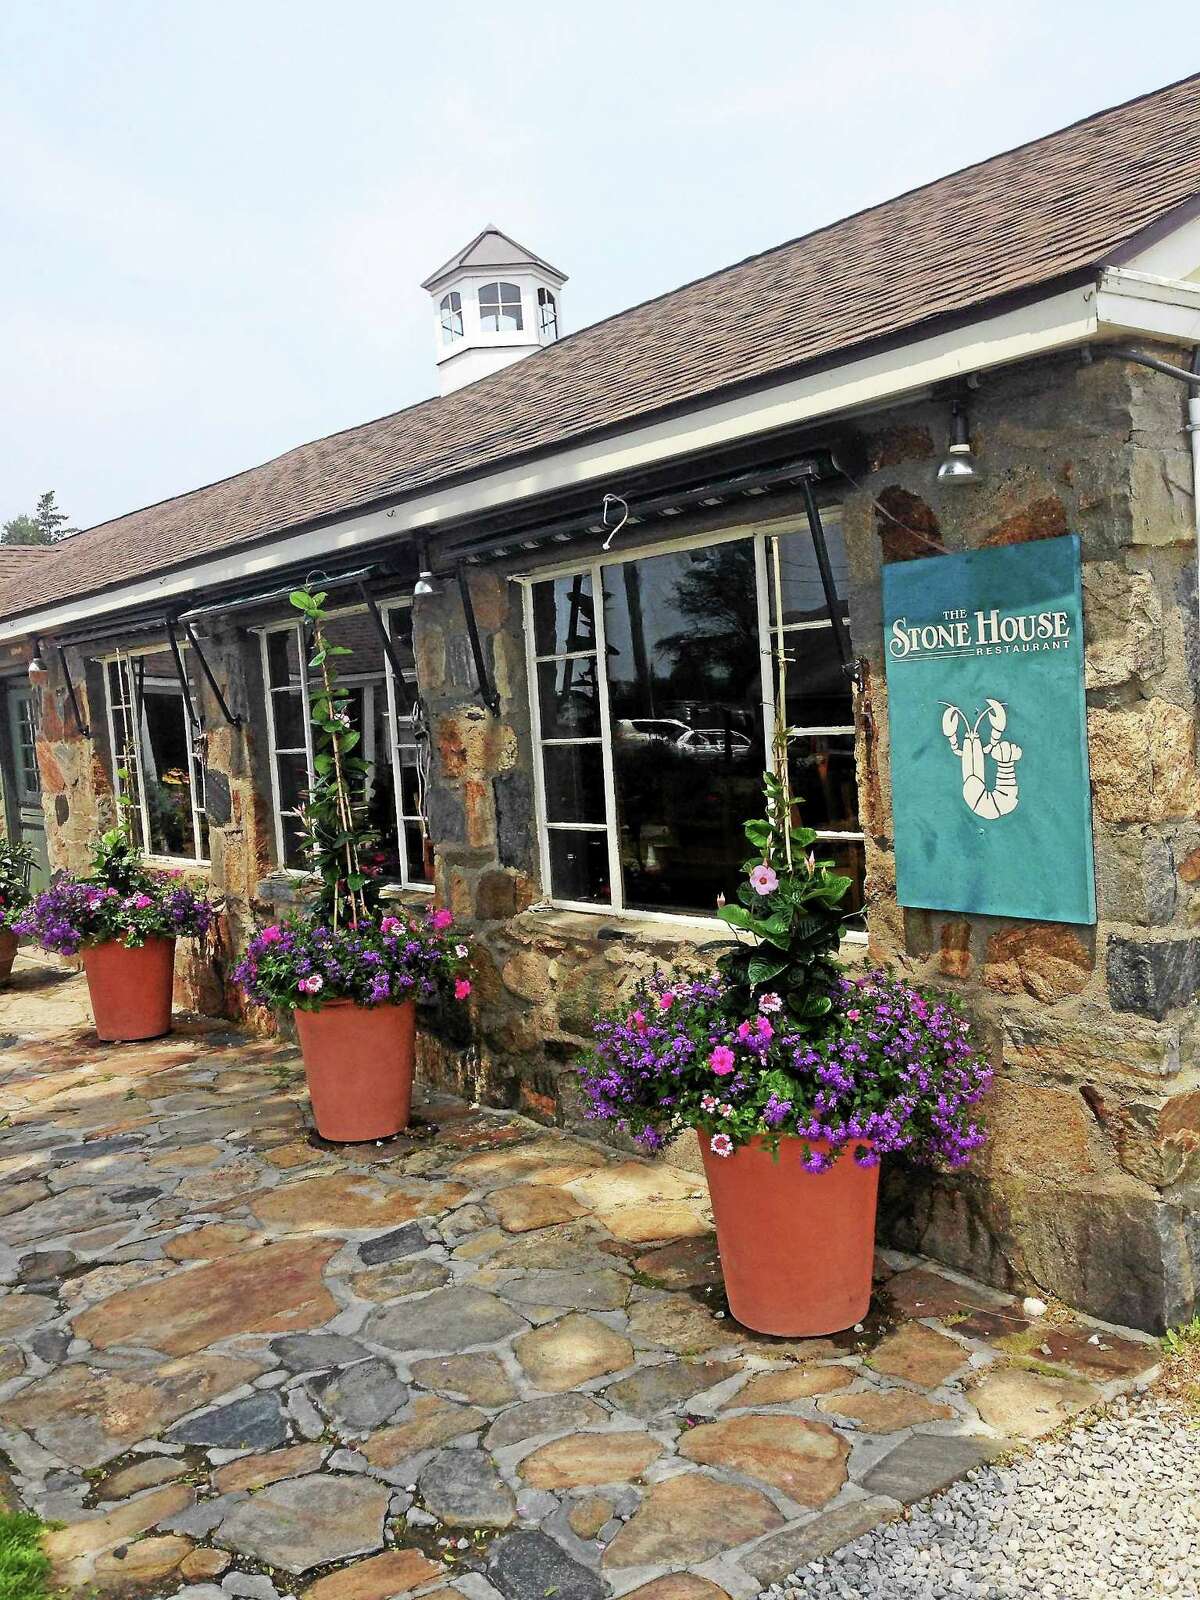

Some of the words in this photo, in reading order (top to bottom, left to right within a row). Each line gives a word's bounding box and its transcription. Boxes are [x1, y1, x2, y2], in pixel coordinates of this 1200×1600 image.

[943, 609, 968, 620] THE
[890, 617, 971, 657] STONE
[974, 609, 1070, 645] HOUSE
[976, 640, 1070, 656] RESTAURANT
